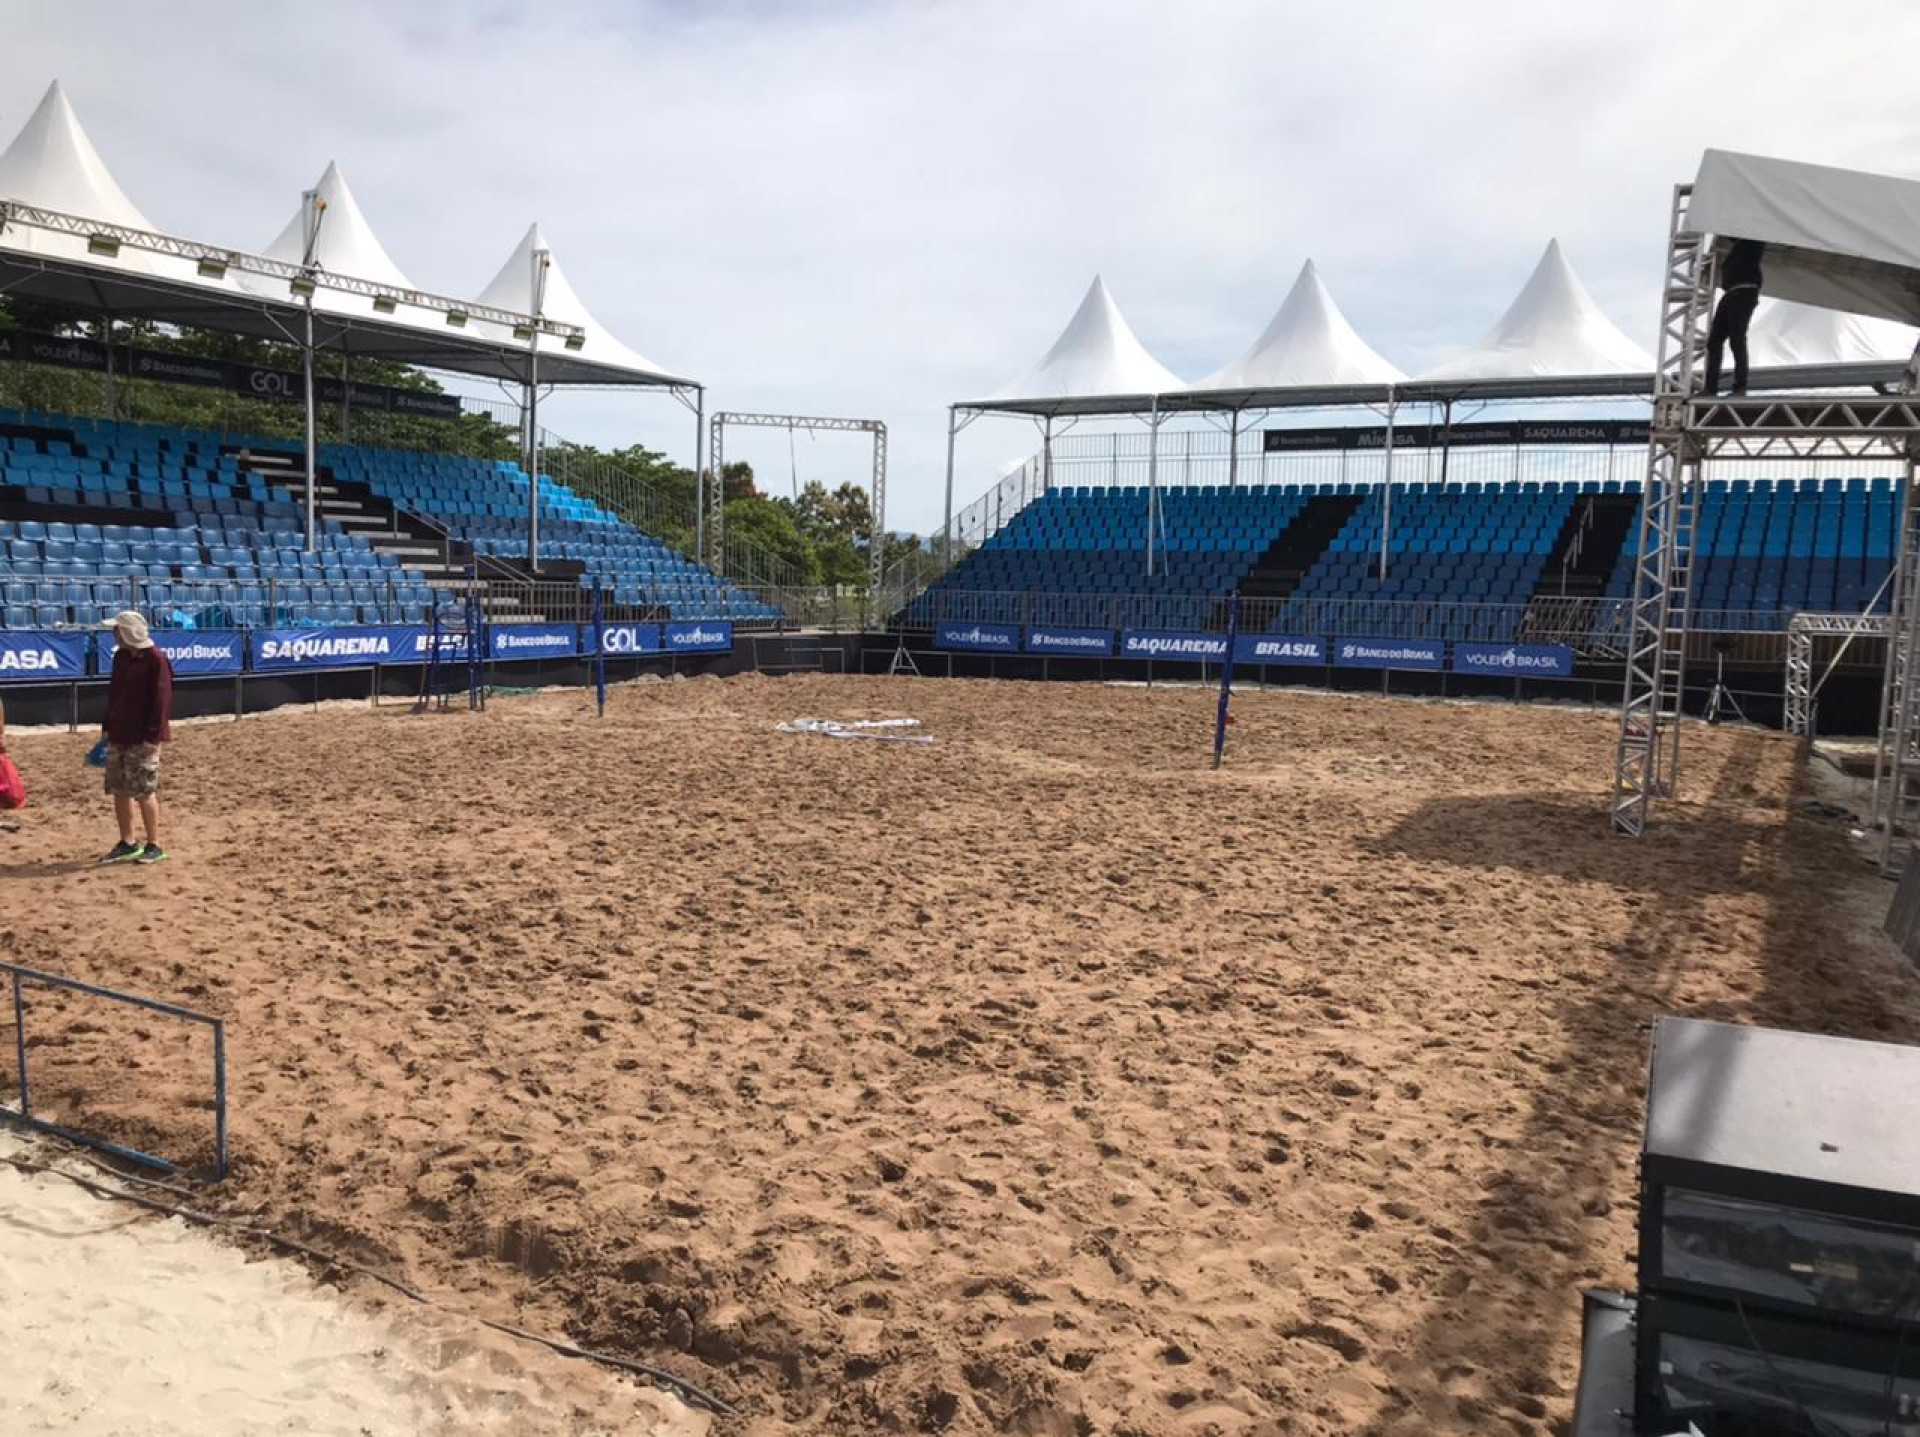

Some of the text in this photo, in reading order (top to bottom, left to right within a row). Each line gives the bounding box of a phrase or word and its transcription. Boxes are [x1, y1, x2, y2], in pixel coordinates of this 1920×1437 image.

[250, 371, 293, 396] GOL
[1523, 426, 1606, 440] SAQUAREMA
[602, 627, 642, 651] GOL
[193, 644, 233, 659] BRASIL
[261, 636, 391, 661] SAQUAREMA
[1255, 642, 1320, 657] BRASIL
[1357, 646, 1435, 660] BANCO DO BRASIL
[1517, 656, 1559, 669] BRASIL
